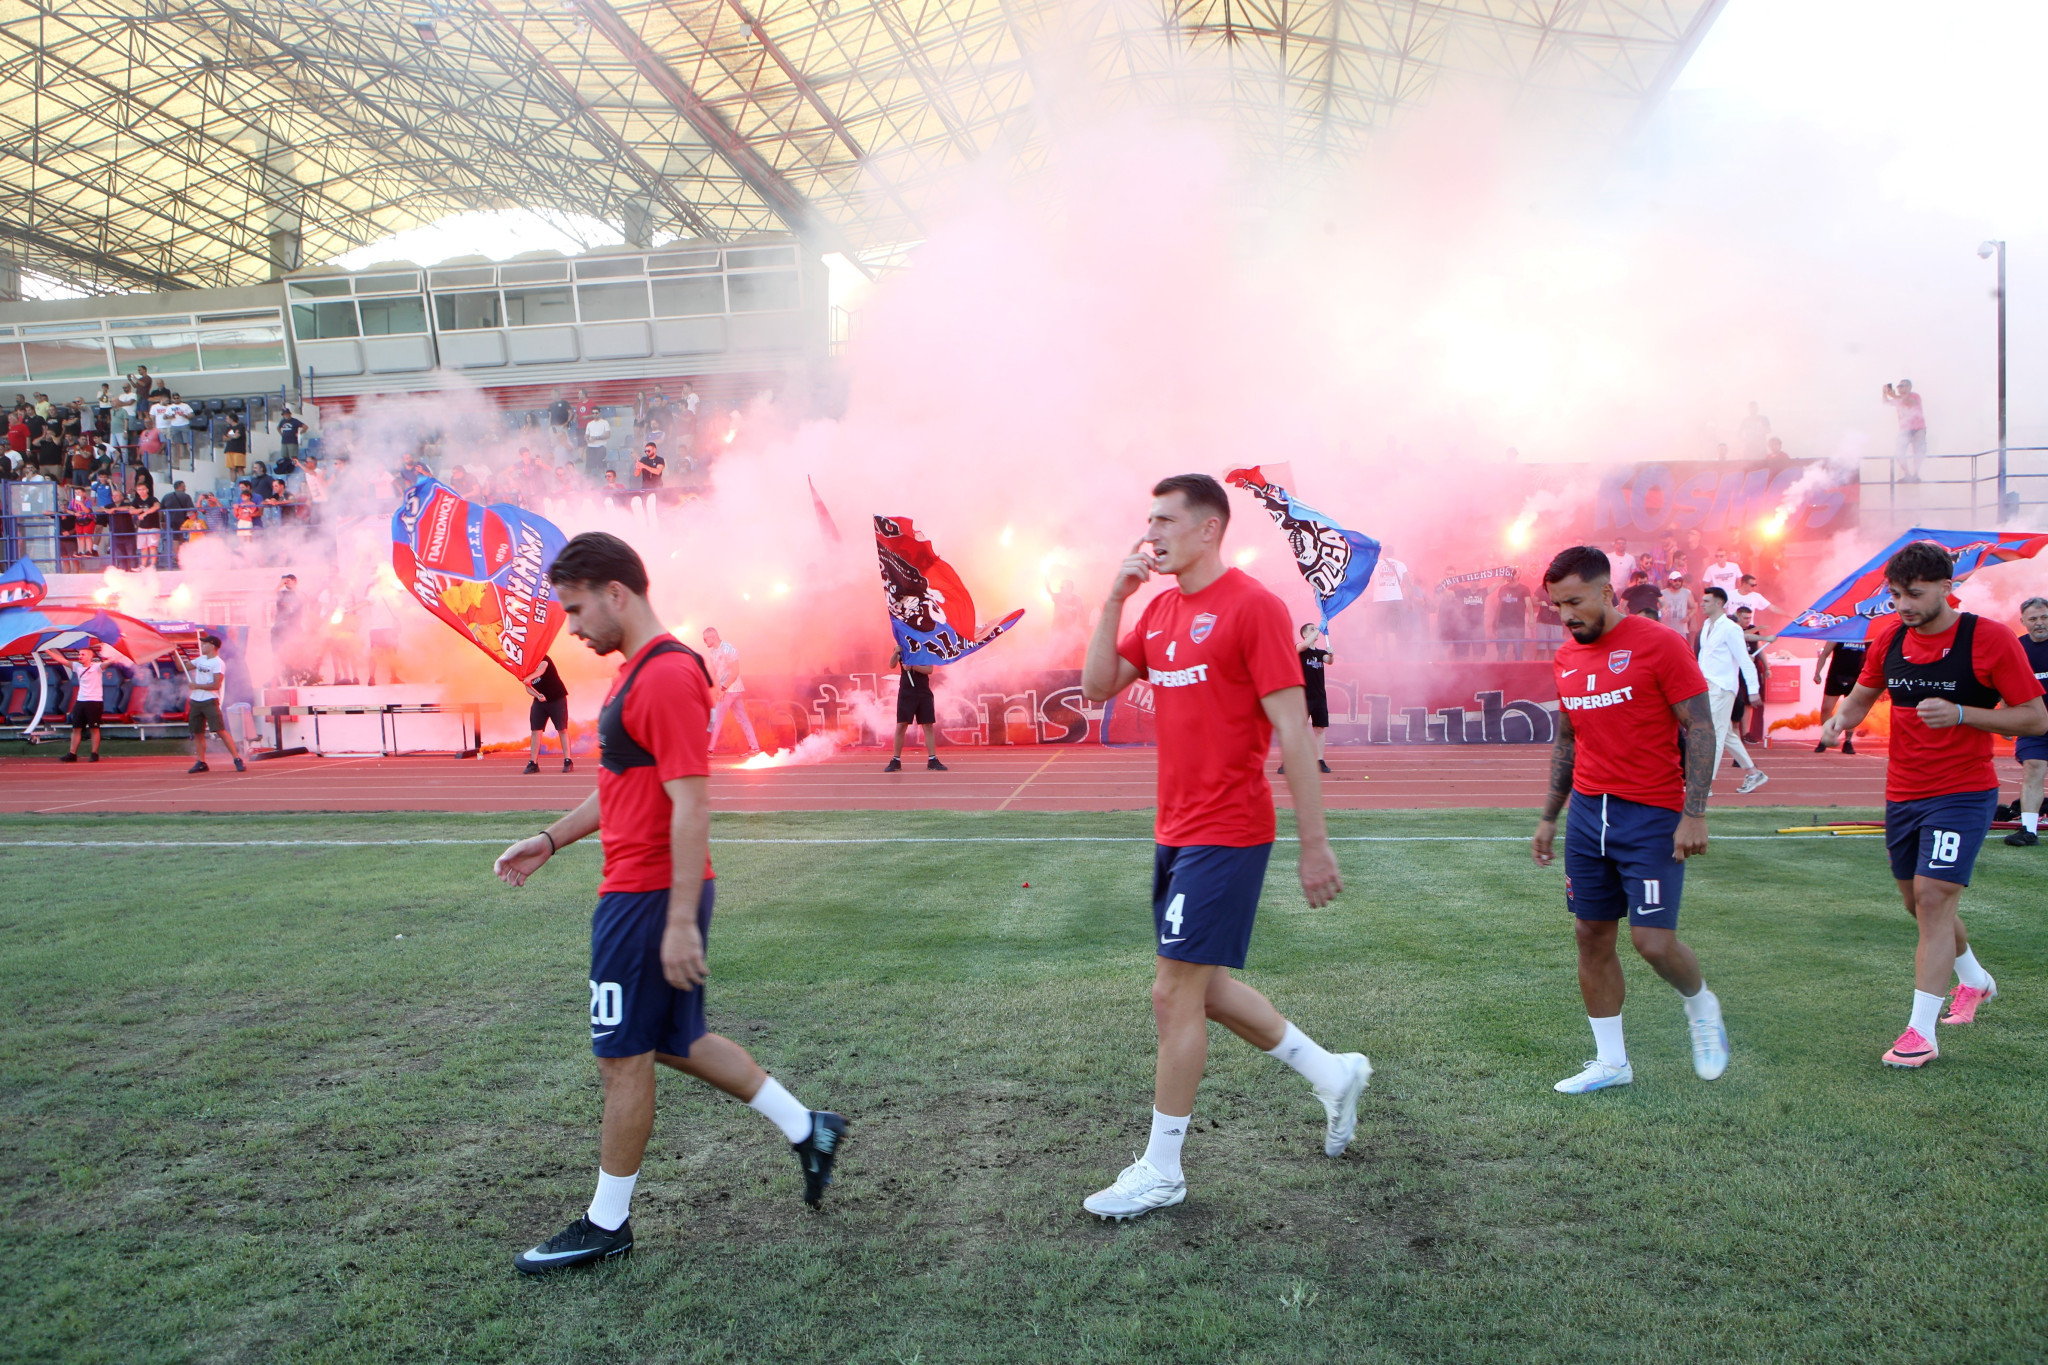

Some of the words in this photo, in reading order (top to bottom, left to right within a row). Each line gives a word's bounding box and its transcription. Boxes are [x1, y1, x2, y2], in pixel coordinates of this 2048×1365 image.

[427, 494, 457, 563] ΠΑΝΙΩΝΙΟΣ
[495, 543, 509, 563] 1890
[1165, 641, 1177, 662] 4
[1586, 674, 1596, 691] 11
[1931, 830, 1961, 862] 18
[1643, 879, 1660, 905] 11
[1165, 893, 1186, 935] 4
[589, 979, 623, 1026] 20
